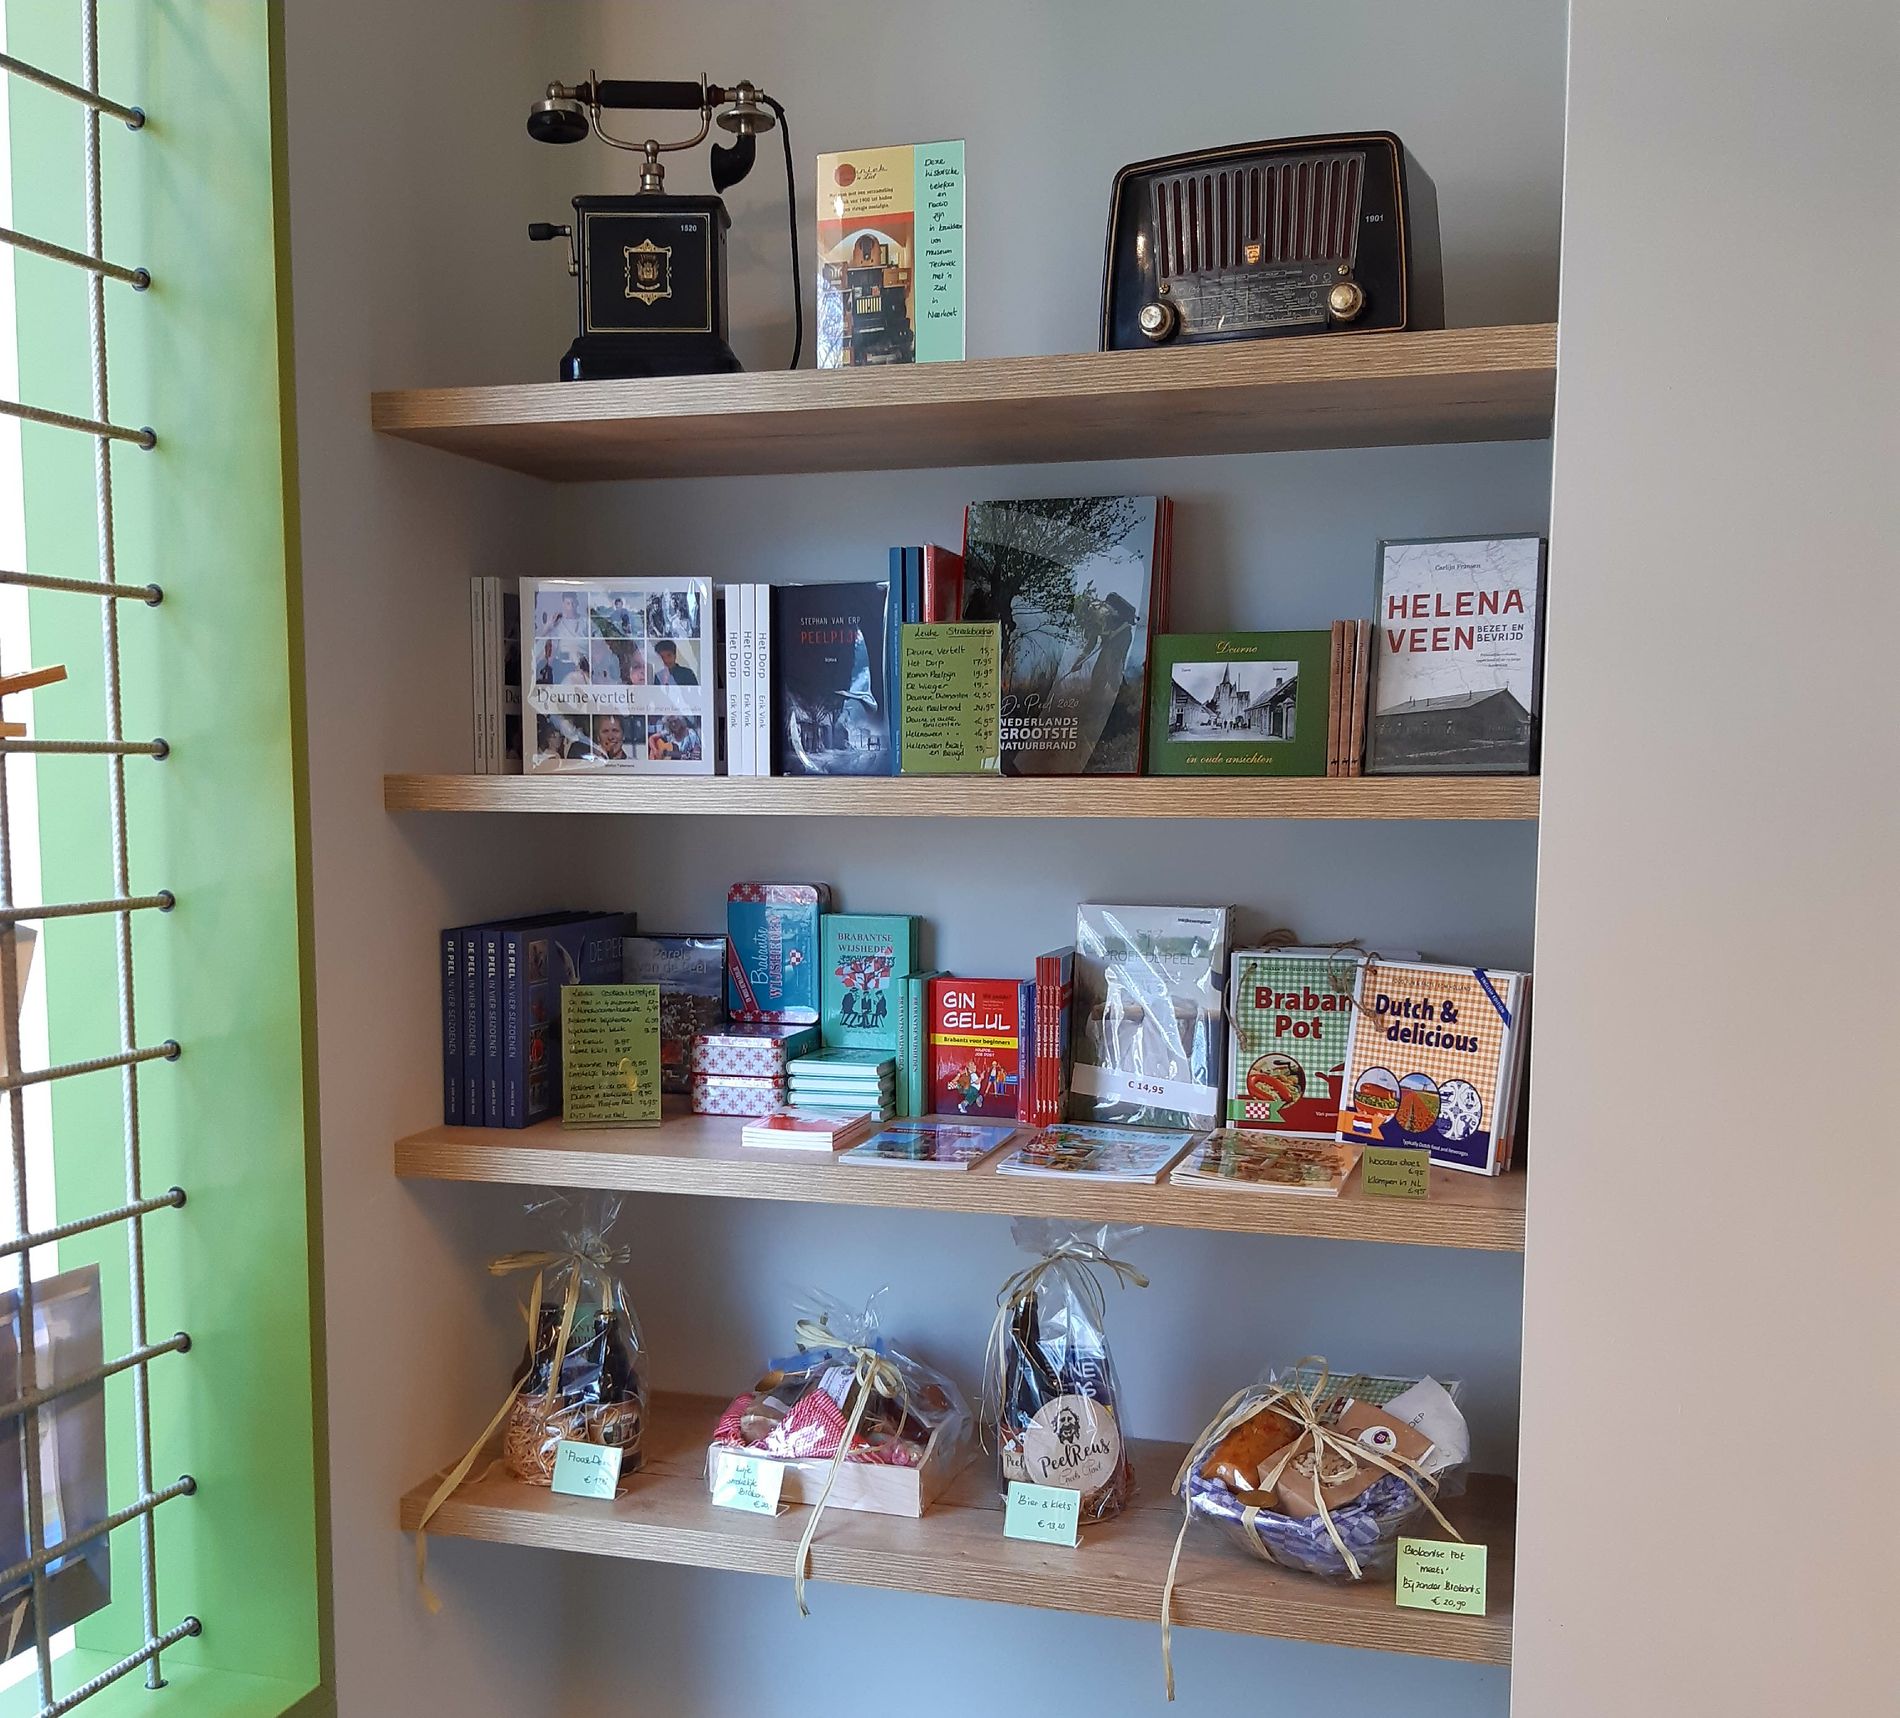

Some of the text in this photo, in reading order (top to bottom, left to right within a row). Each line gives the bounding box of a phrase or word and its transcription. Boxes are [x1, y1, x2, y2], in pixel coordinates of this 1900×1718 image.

[1365, 214, 1384, 223] 1901
[681, 224, 697, 232] 1520
[1388, 589, 1524, 620] HELENA
[800, 617, 828, 625] STEPHAN
[832, 616, 844, 625] VAN
[1388, 626, 1474, 653] VEEN
[1477, 625, 1508, 633] BEZET
[1477, 632, 1523, 642] BEVRIJD
[728, 632, 739, 678] Het Dorp
[743, 631, 752, 677] Het Dorp
[1216, 640, 1258, 654] Deurne
[758, 632, 767, 679] Het Dorp
[537, 688, 635, 704] Deurne vertelt
[1000, 717, 1078, 727] NEDERLANDS
[1000, 727, 1078, 740] GROOTSTE
[1000, 741, 1077, 751] NATUURBRAND
[1186, 752, 1273, 764] in oude ansichten
[838, 932, 894, 942] BRABANTSE
[447, 941, 454, 954] DE
[468, 942, 475, 954] DE
[488, 942, 495, 955] DE
[508, 943, 515, 955] DE
[838, 944, 894, 954] WIJSHEDEN
[468, 955, 476, 977] PEEL
[1165, 952, 1194, 965] PEEL
[488, 956, 496, 978] PEEL
[508, 956, 516, 979] PEEL
[943, 991, 975, 1009] GIN
[1255, 986, 1352, 1012] Braban
[1375, 994, 1458, 1024] Dutch &
[943, 1011, 1011, 1030] GELUL
[1274, 1015, 1322, 1039] Pot
[469, 1010, 477, 1056] SEIZOENEN
[489, 1010, 497, 1057] SEIZOENEN
[1386, 1019, 1478, 1053] delicious
[1137, 1083, 1164, 1095] 14,95
[1408, 1412, 1425, 1429] OEP
[1005, 1453, 1024, 1469] Peel
[1038, 1438, 1111, 1478] PeelReus
[1037, 1520, 1045, 1528] €
[1431, 1597, 1467, 1610] € 20,90
